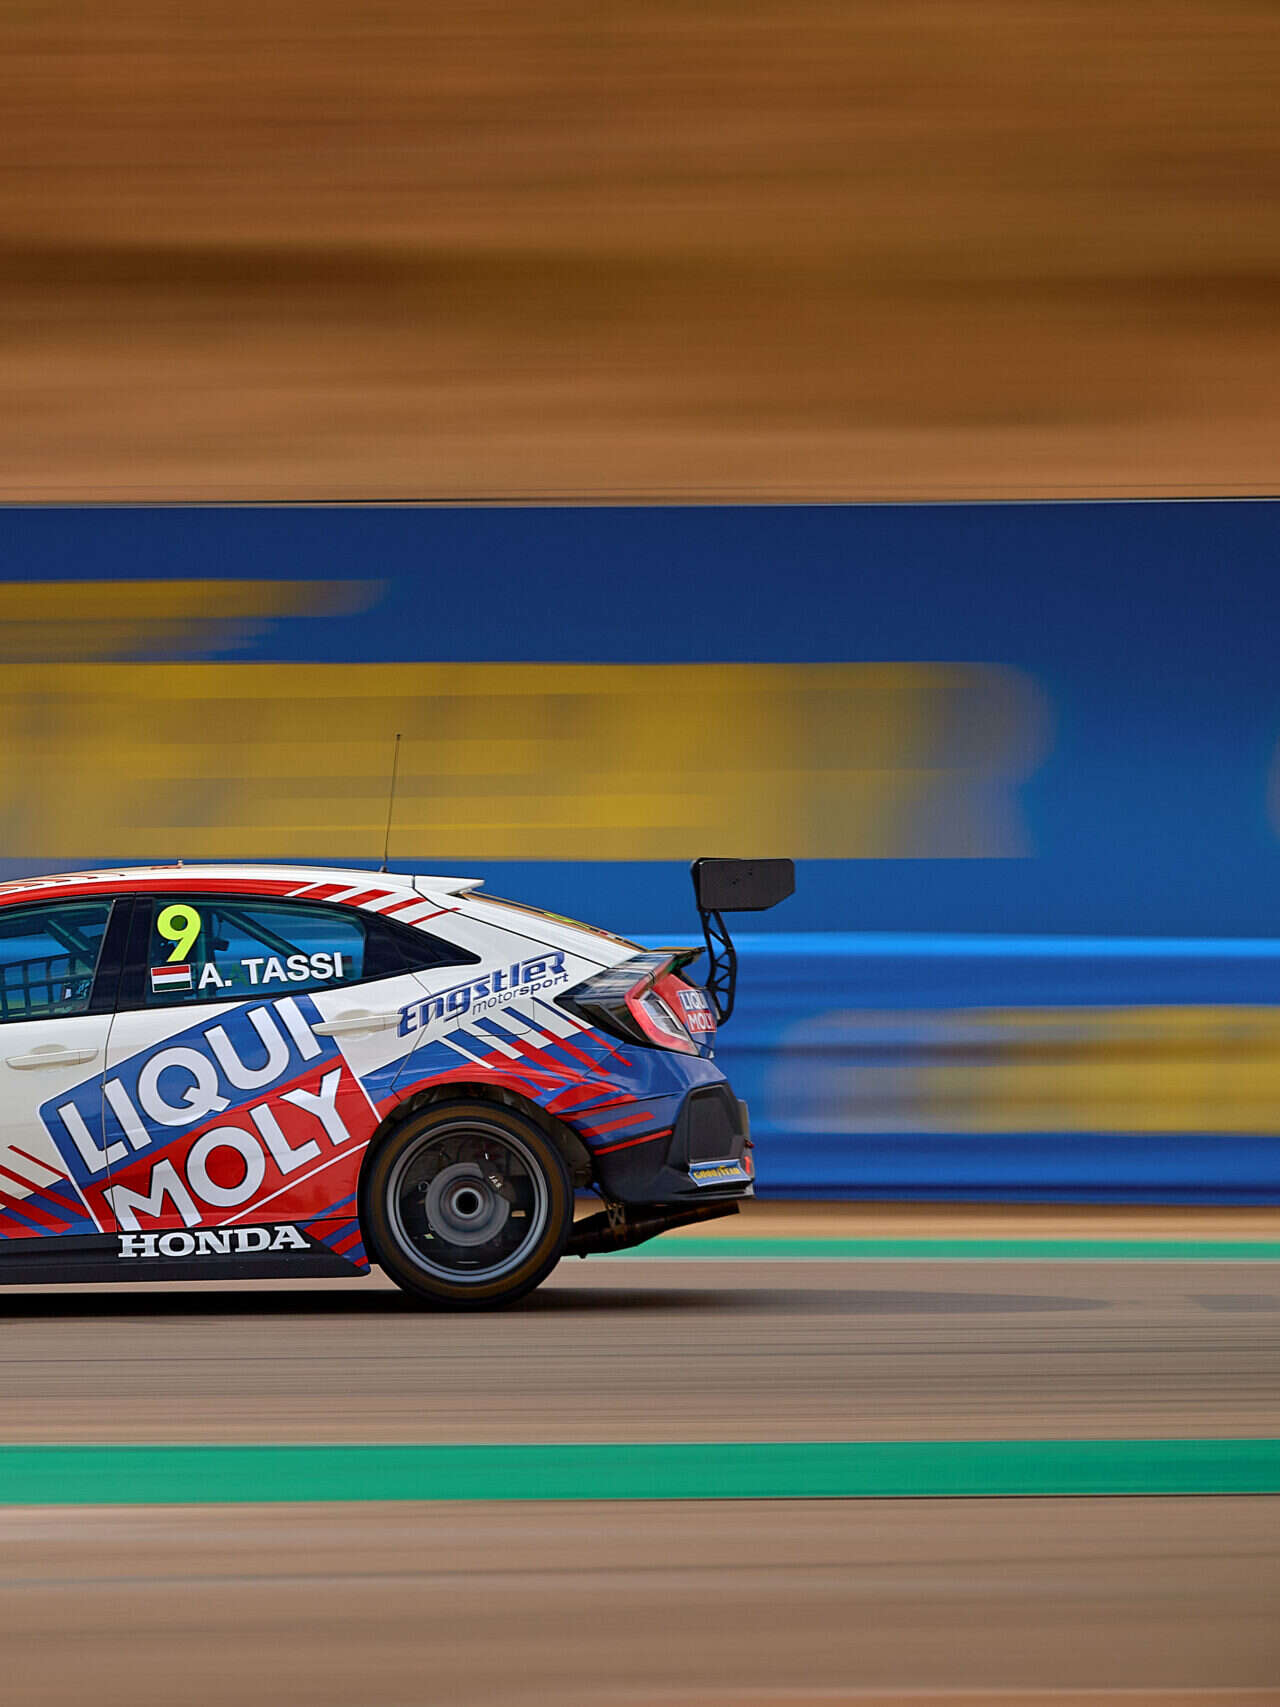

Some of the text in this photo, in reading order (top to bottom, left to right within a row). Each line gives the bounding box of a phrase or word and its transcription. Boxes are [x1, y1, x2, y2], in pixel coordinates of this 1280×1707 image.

[157, 904, 201, 962] 9
[198, 951, 344, 990] A. TASSI
[473, 972, 568, 1015] motorsport
[58, 997, 322, 1174] LIQUI
[103, 1067, 350, 1231] MOLY
[118, 1226, 310, 1257] HONDA
